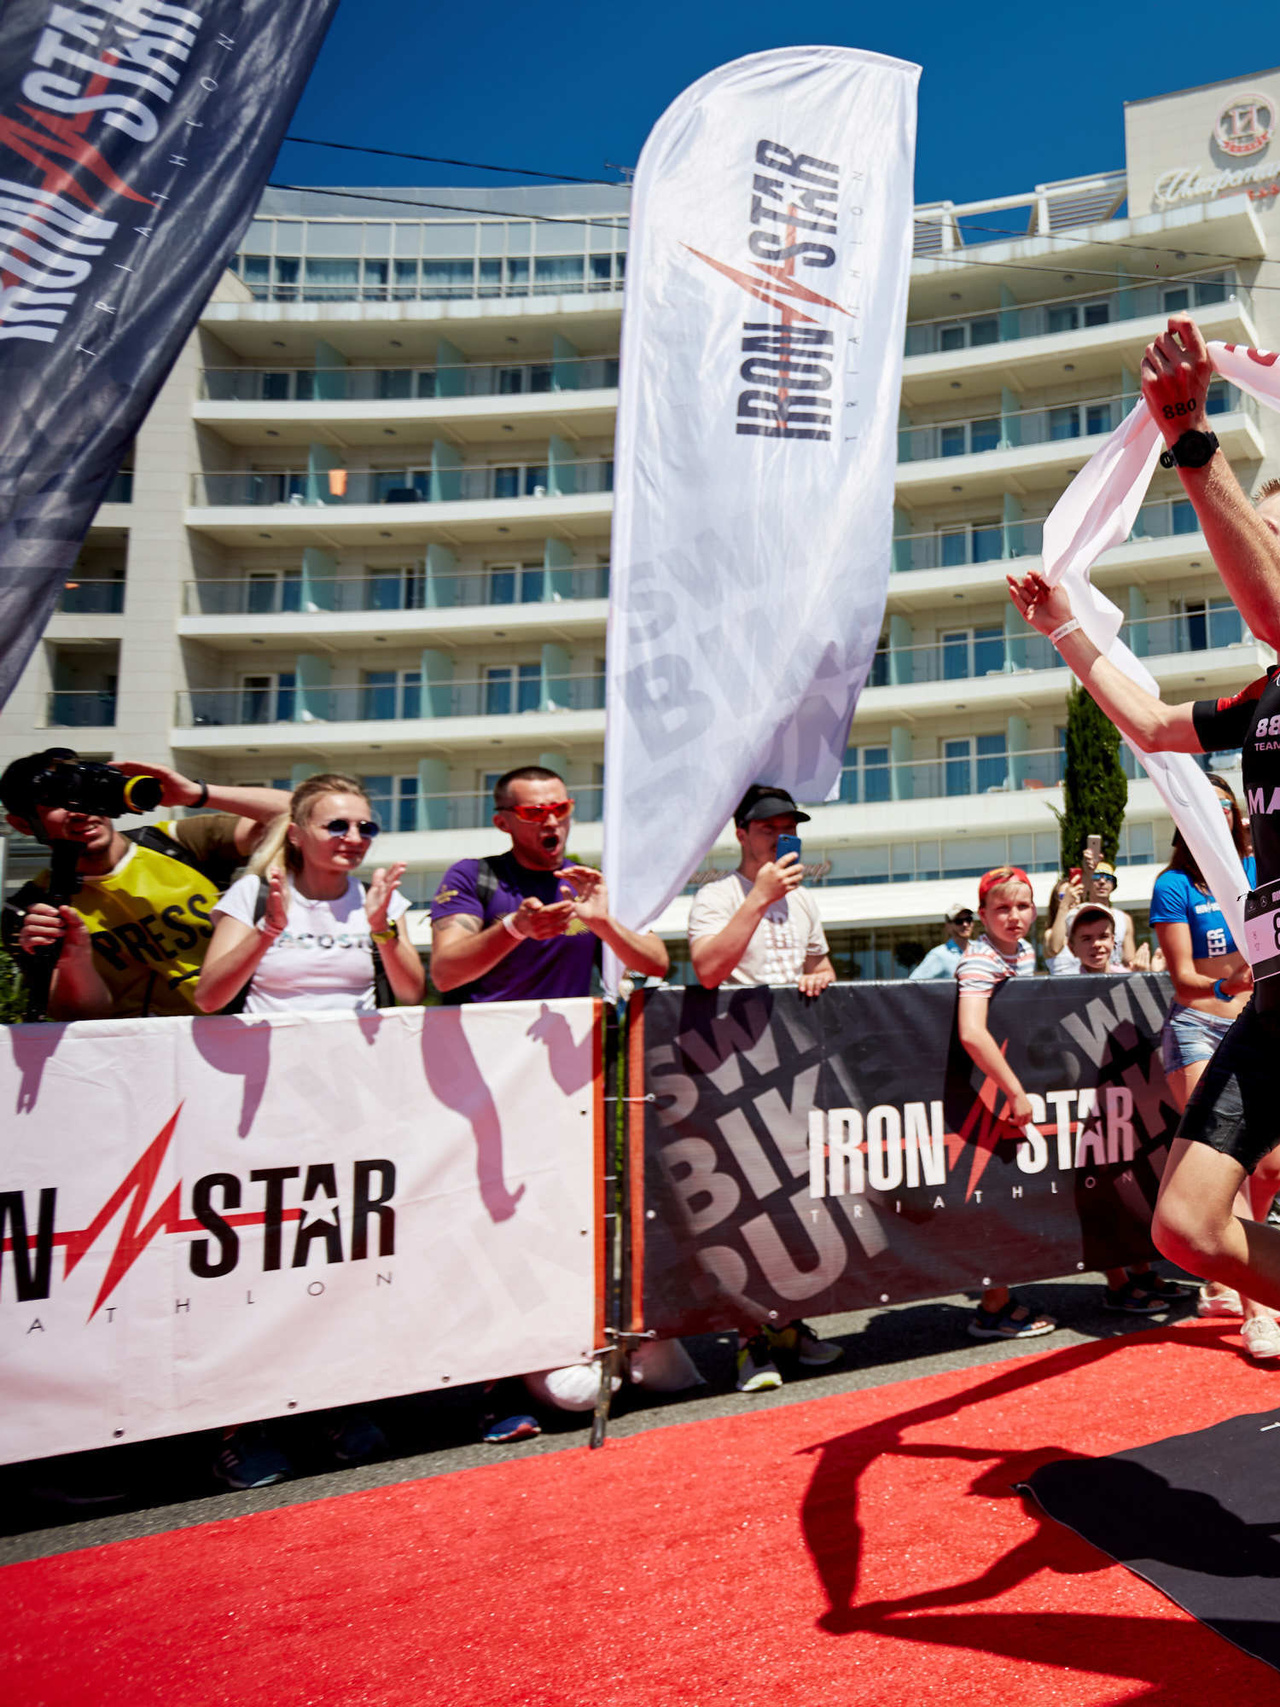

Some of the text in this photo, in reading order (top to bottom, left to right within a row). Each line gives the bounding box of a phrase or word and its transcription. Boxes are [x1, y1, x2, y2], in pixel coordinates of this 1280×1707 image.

[736, 138, 840, 442] IRON STAR
[844, 170, 865, 442] TRIATHLON
[1162, 398, 1197, 420] 880
[91, 892, 216, 972] PRESS
[807, 1100, 947, 1199] IRON
[1016, 1086, 1135, 1175] STAR
[811, 1172, 1134, 1224] TRIATHLON
[190, 1159, 397, 1279] STAR
